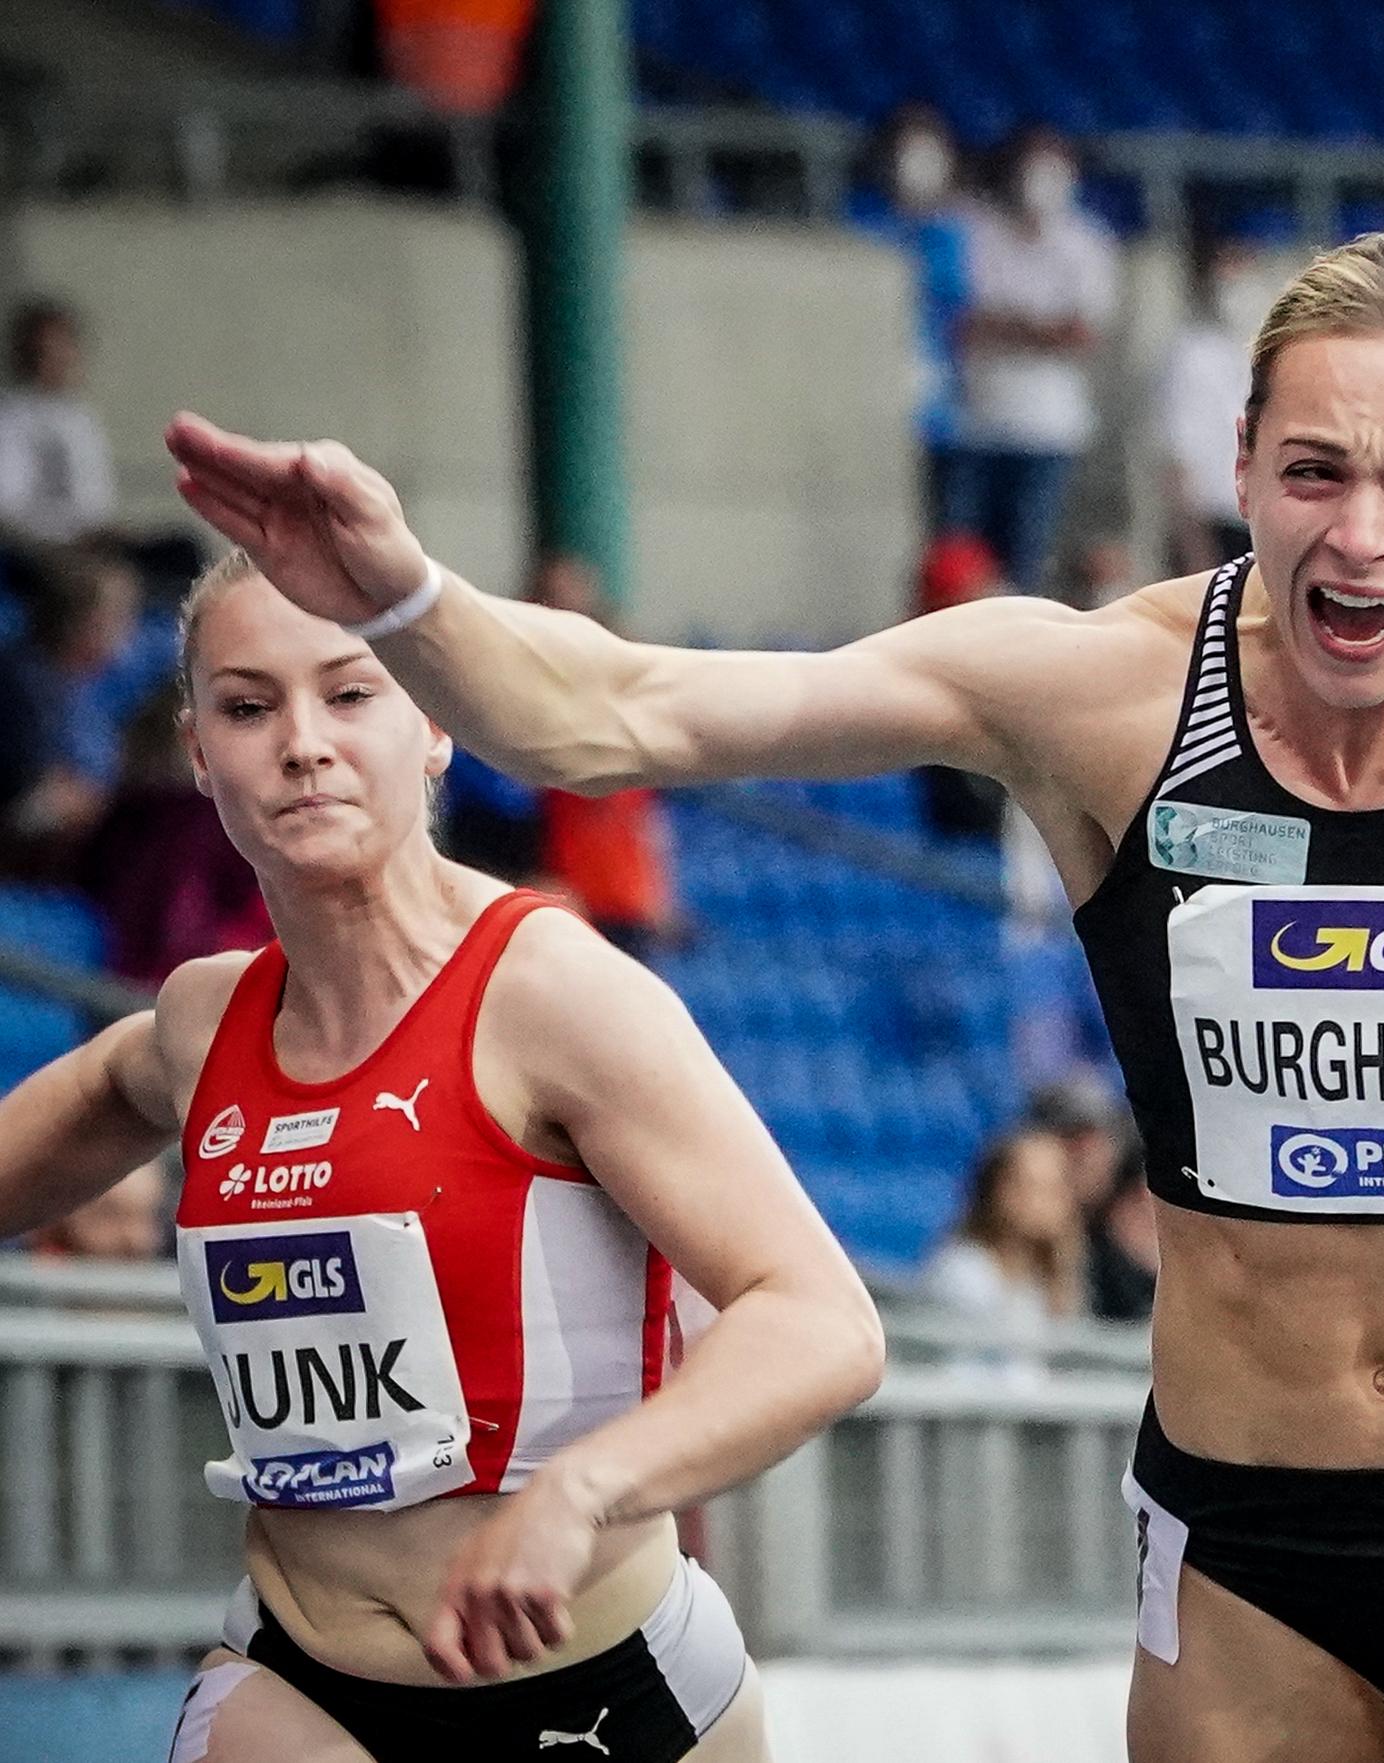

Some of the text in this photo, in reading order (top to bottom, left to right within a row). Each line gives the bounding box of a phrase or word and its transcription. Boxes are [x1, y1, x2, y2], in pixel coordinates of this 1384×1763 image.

[1212, 817, 1306, 839] BURGHAUSEN
[275, 1115, 334, 1133] SPORTHILFE
[254, 1161, 333, 1193] LOTTO
[288, 1257, 345, 1299] GLS
[221, 1338, 427, 1430] JUNK
